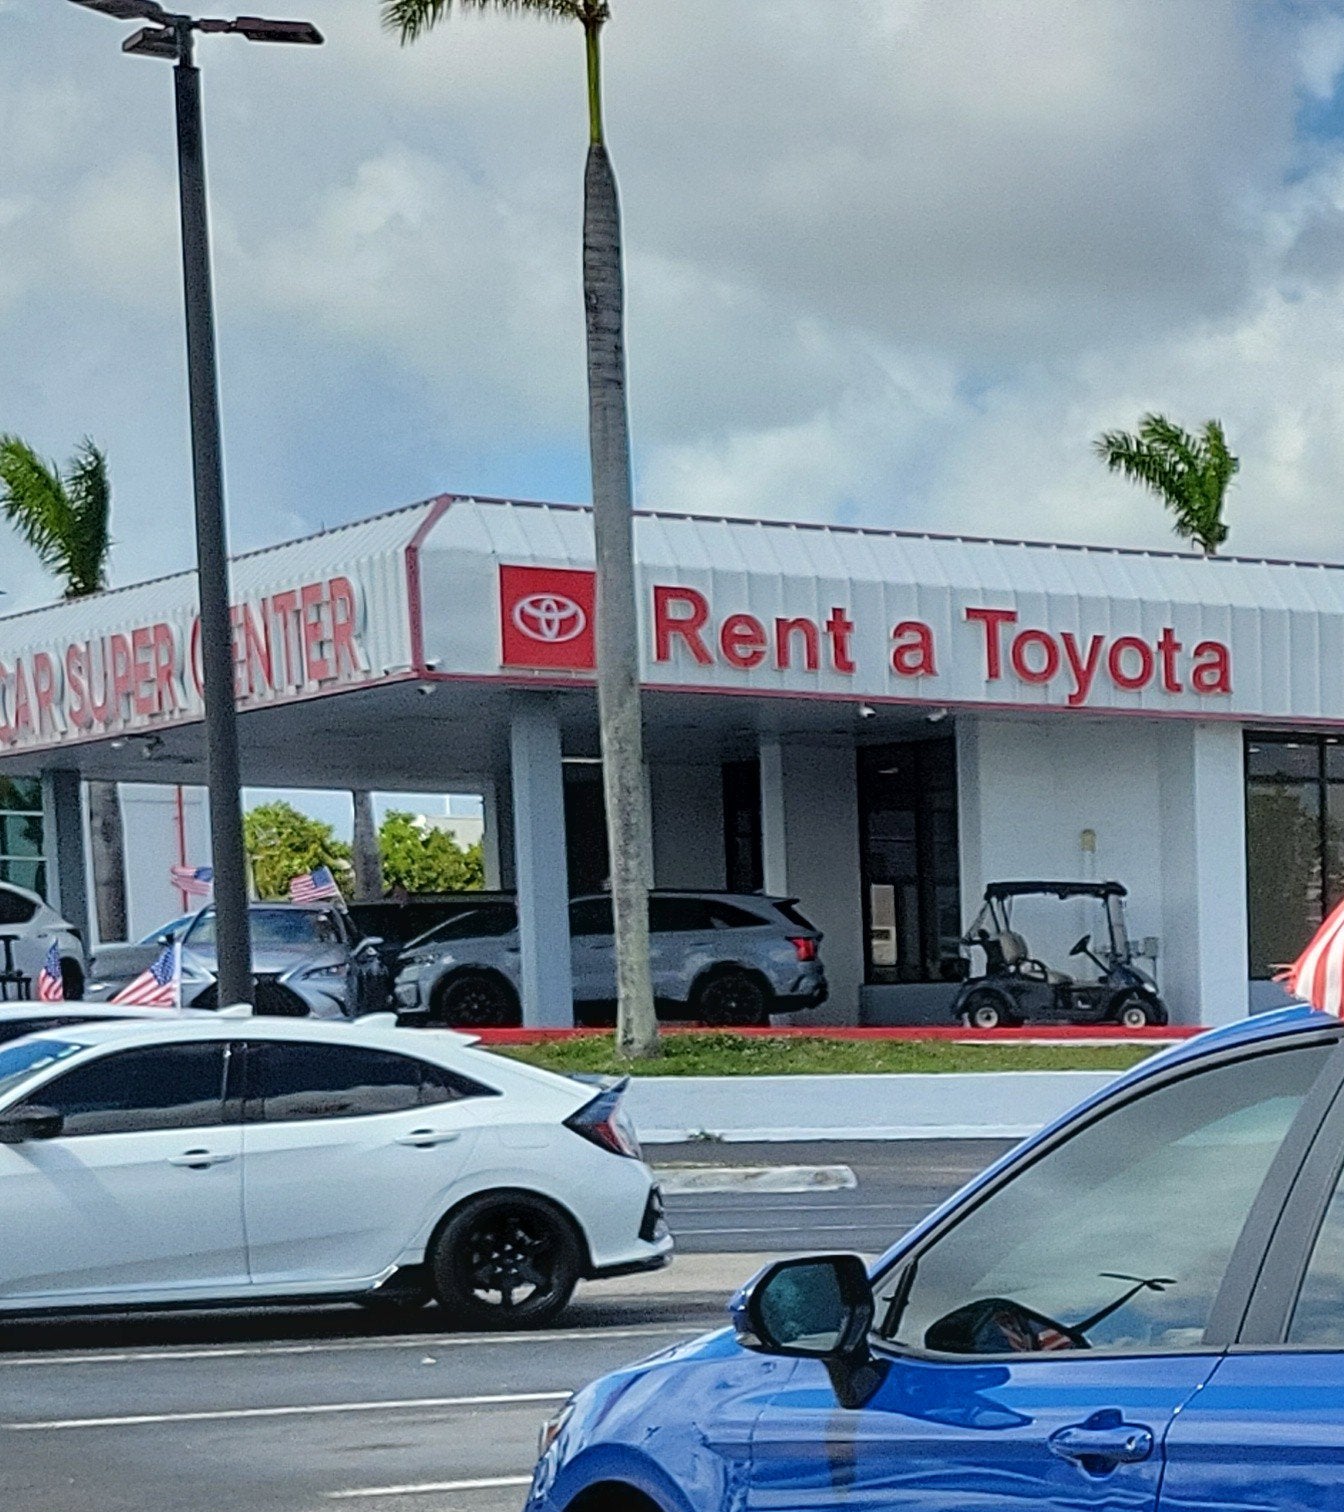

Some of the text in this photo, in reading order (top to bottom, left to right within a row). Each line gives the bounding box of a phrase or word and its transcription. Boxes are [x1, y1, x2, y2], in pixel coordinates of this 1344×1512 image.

[65, 622, 181, 729] SUPER
[652, 585, 1233, 707] Rent a Toyota
